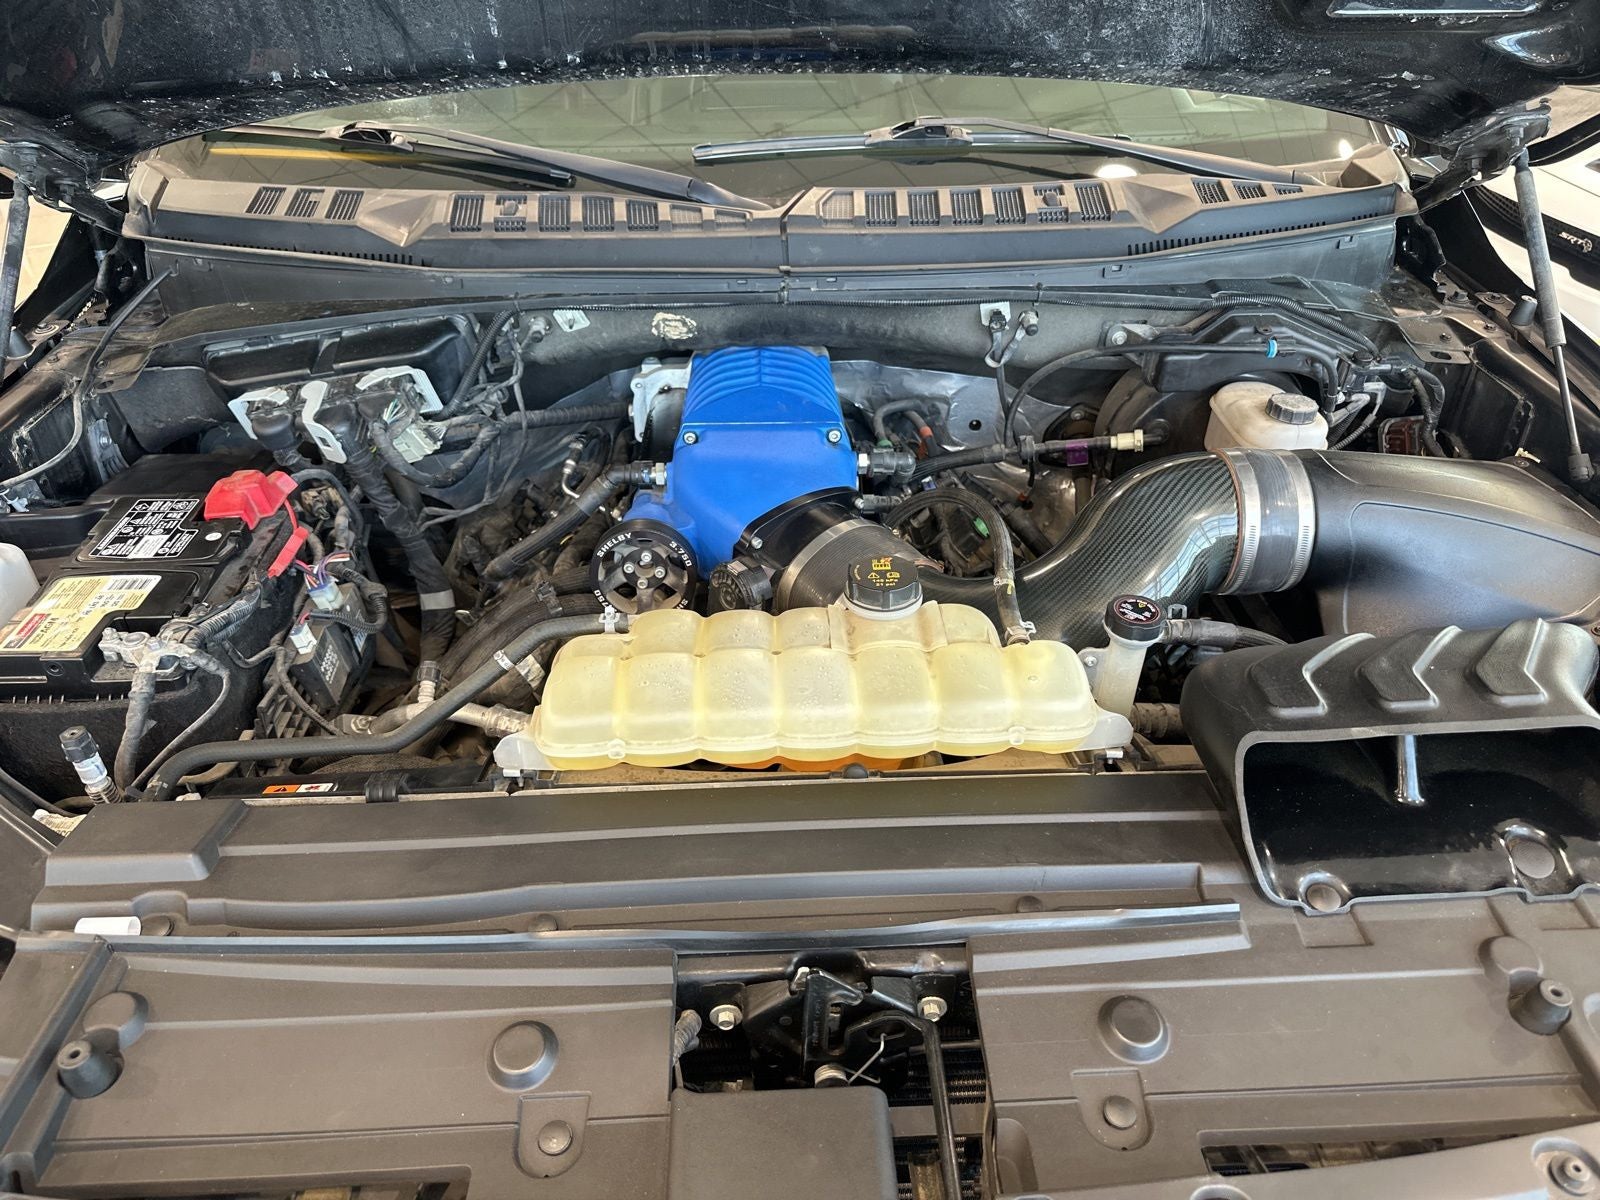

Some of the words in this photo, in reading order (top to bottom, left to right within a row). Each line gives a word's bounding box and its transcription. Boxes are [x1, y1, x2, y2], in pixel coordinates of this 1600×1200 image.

[1559, 231, 1585, 245] SRT
[596, 532, 632, 558] SHELBY
[669, 540, 692, 567] 3.750
